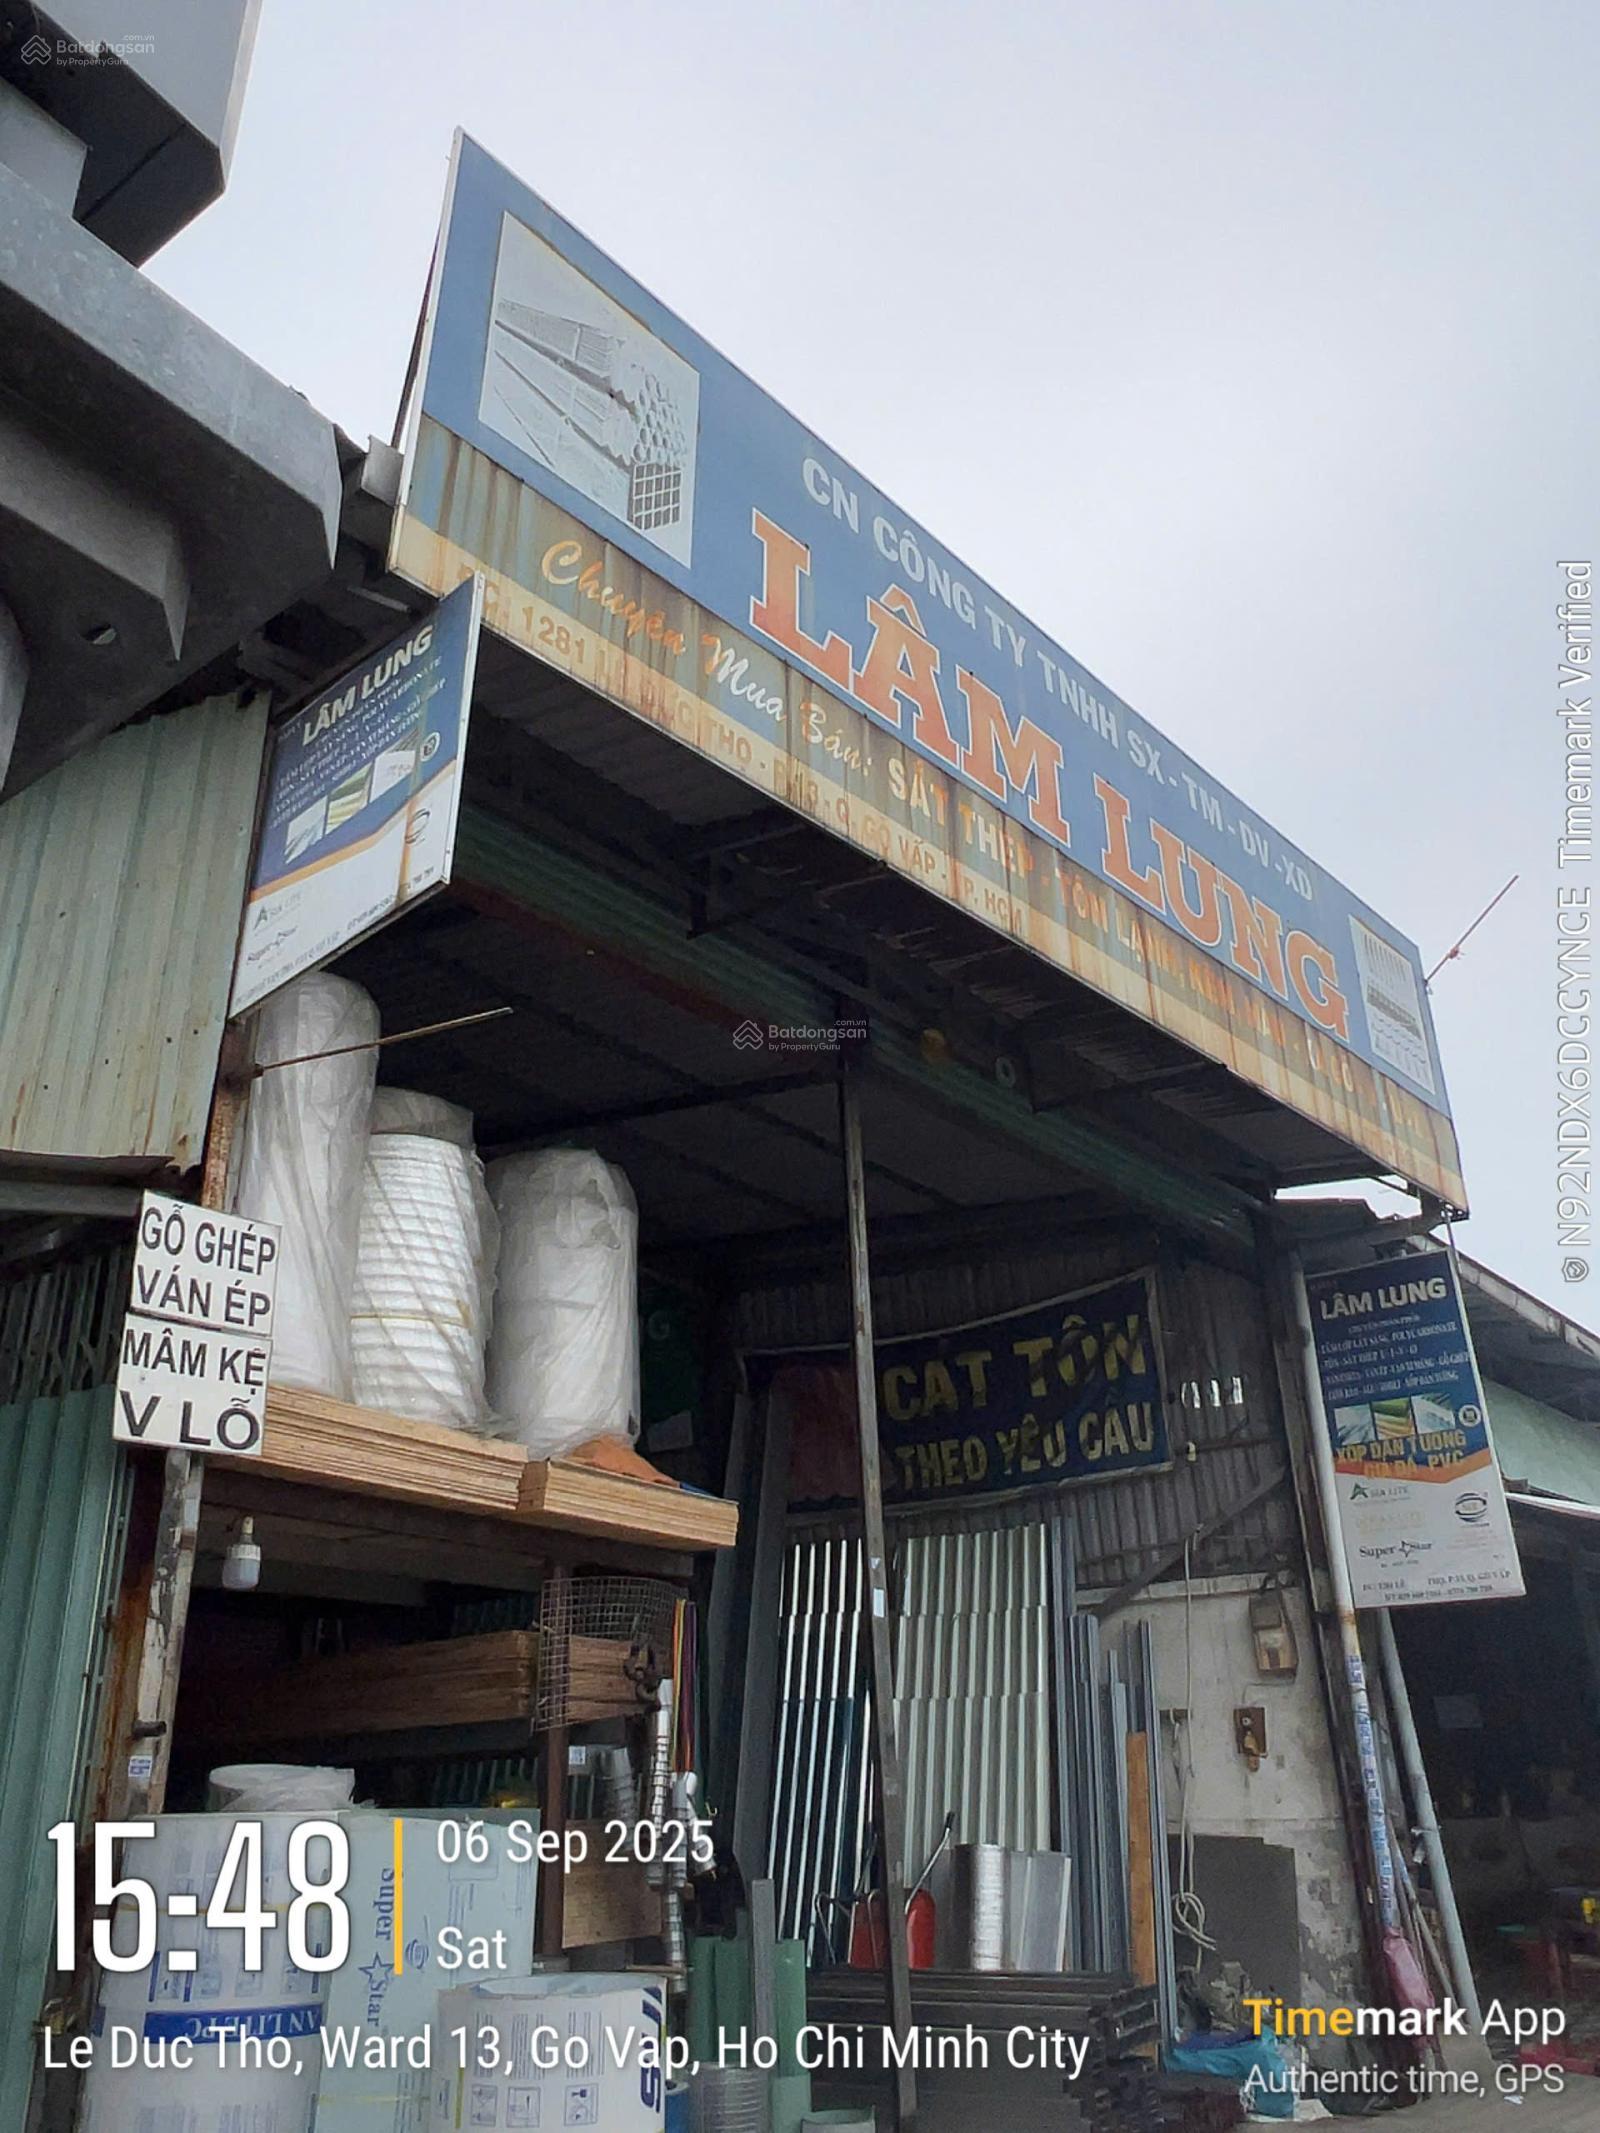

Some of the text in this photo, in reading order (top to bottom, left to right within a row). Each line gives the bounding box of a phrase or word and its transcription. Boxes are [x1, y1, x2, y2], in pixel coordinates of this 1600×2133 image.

[522, 606, 586, 664] 1281
[803, 458, 859, 534] CN
[873, 516, 977, 631] CÔNG
[984, 606, 1026, 667] TY
[1037, 650, 1119, 750] TNHH
[303, 686, 356, 746] LÂM
[361, 625, 433, 699] LUNG
[702, 633, 787, 721] Mua
[750, 508, 1070, 848] LÂM
[1094, 773, 1349, 1042] LUNG
[141, 1204, 276, 1276] GỖ GHÉP
[137, 1264, 272, 1327] VÁN ÉP
[1320, 1277, 1447, 1320] LÂM LUNG
[122, 1327, 267, 1395] MÂM KỆ
[896, 1435, 988, 1490] THEO
